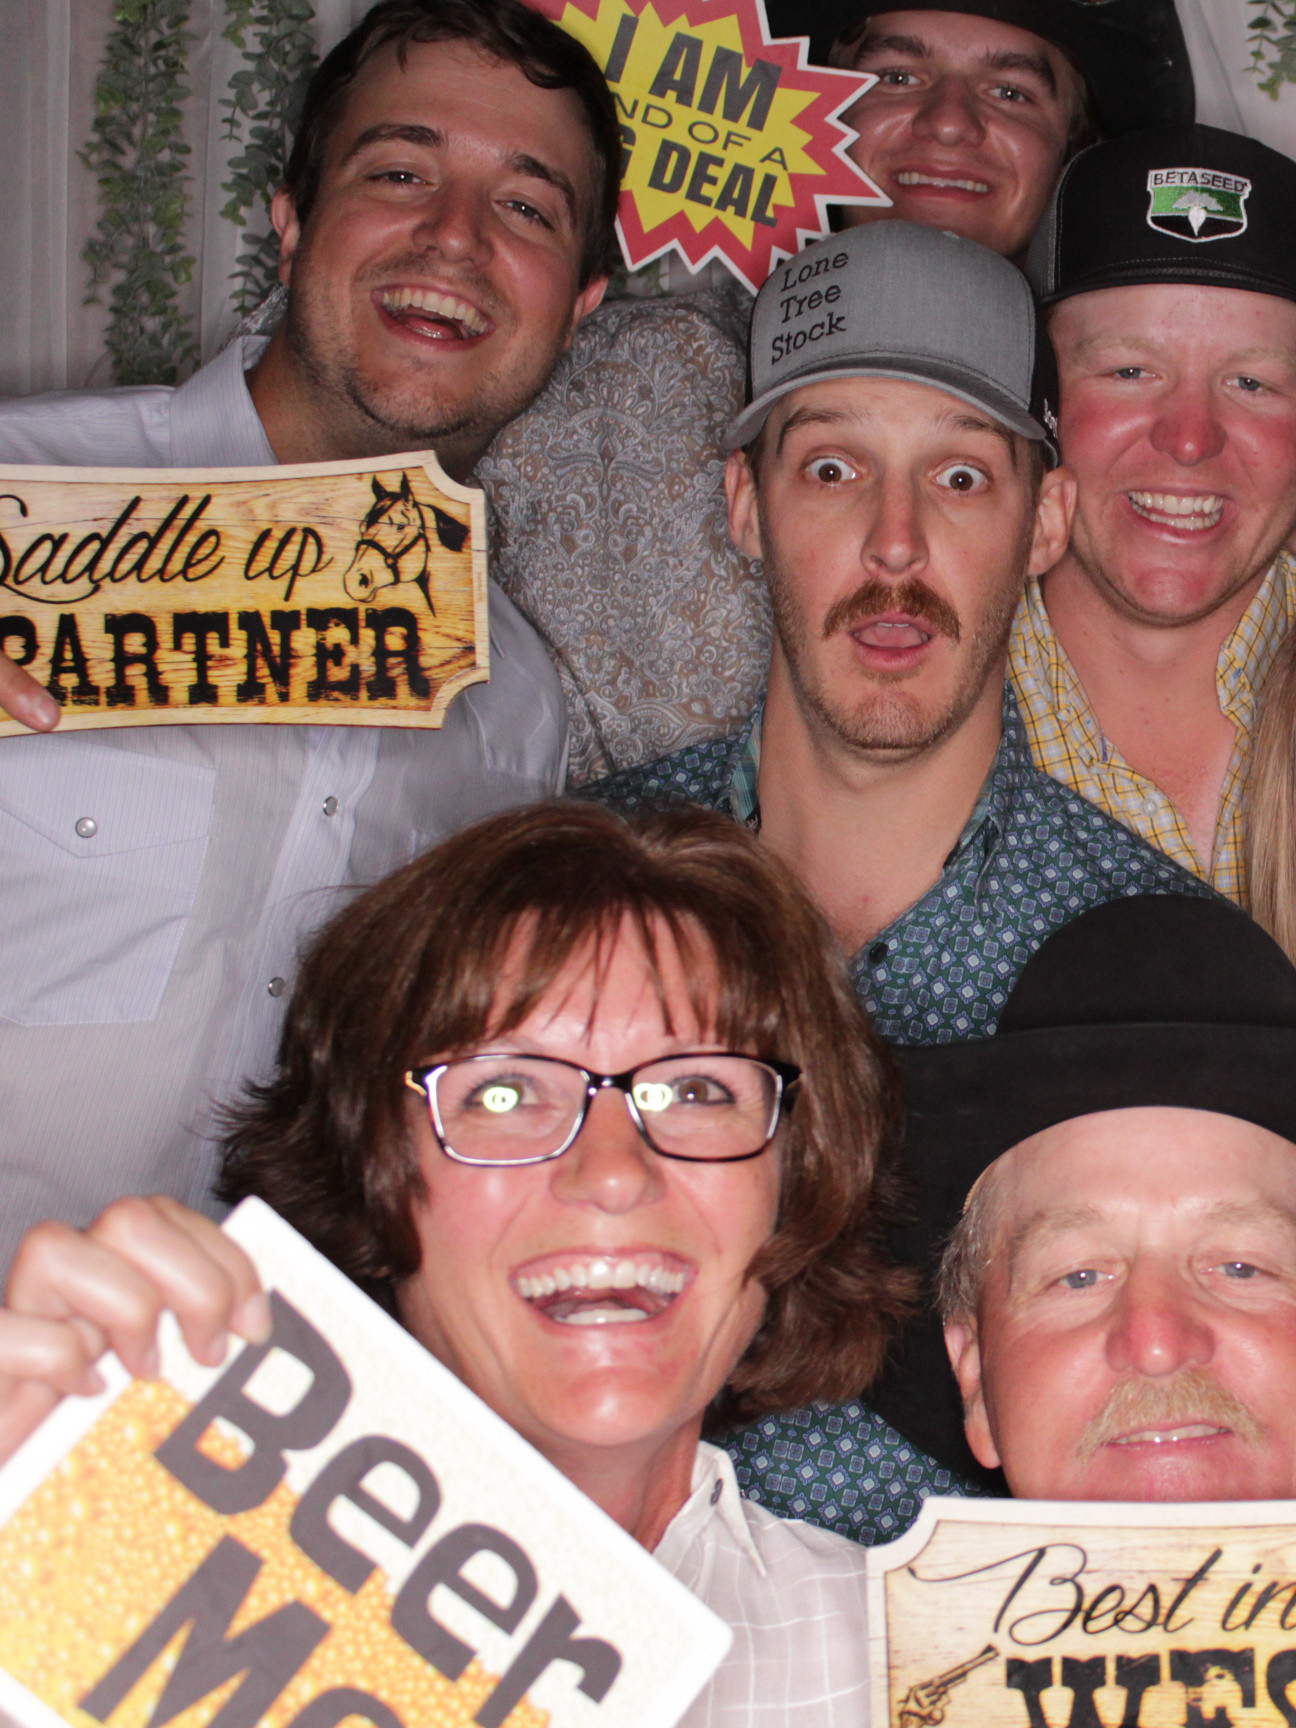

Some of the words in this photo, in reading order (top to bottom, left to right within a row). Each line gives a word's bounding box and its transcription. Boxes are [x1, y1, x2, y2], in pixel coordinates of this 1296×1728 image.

[604, 13, 639, 83] I
[648, 31, 783, 131] AM
[614, 92, 673, 129] ND
[687, 121, 752, 151] OF
[759, 146, 788, 171] A
[647, 138, 778, 228] DEAL
[1153, 171, 1246, 193] BETASEED
[780, 252, 849, 292] Lone
[780, 285, 842, 324] Tree
[771, 312, 847, 366] Stock
[244, 527, 334, 601] up
[154, 1289, 623, 1728] Beer
[77, 1533, 408, 1728] M
[907, 1543, 1222, 1647] Best
